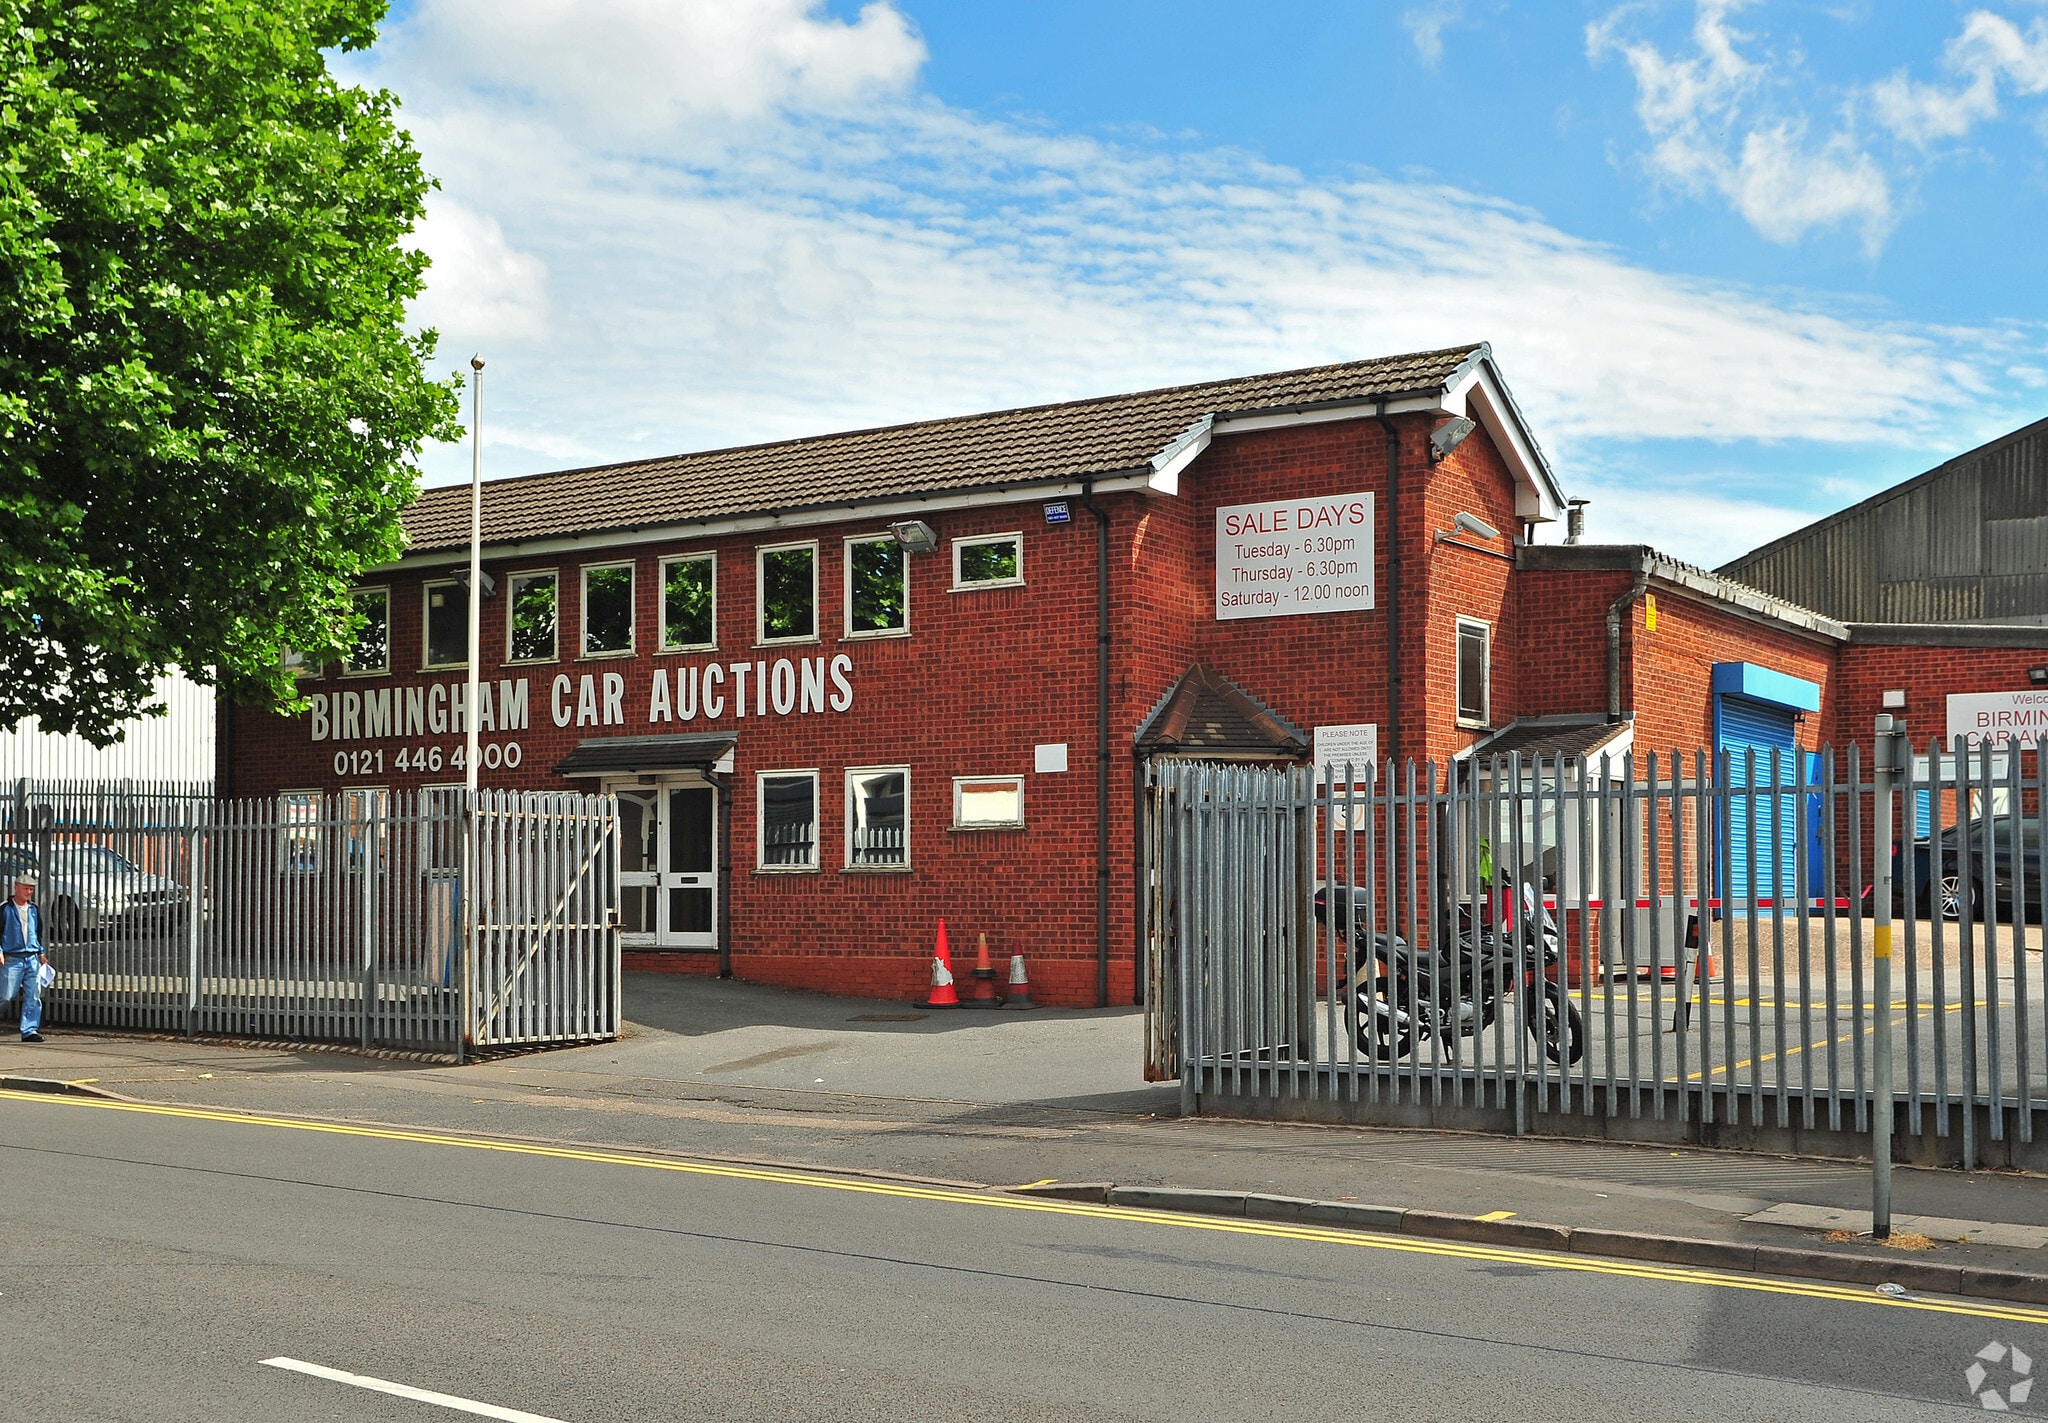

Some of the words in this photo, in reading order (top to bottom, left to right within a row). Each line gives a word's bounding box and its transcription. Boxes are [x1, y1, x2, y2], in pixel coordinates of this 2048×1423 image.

[1225, 510, 1288, 536] SALE
[1297, 502, 1365, 530] DAYS
[1234, 541, 1290, 559] Tuesday
[1304, 536, 1355, 555] 6.30pm
[1232, 565, 1293, 583] Thursday
[1307, 559, 1358, 578] 6.30pm
[1221, 588, 1279, 607] Saturday
[1294, 584, 1331, 601] 12.00
[1335, 584, 1369, 598] noon
[311, 678, 529, 741] BIRMINGHAM
[551, 672, 625, 728] CAR
[649, 653, 853, 723] AUCTIONS
[1350, 729, 1368, 737] NOTE
[334, 748, 384, 776] 0121
[395, 746, 443, 772] 446
